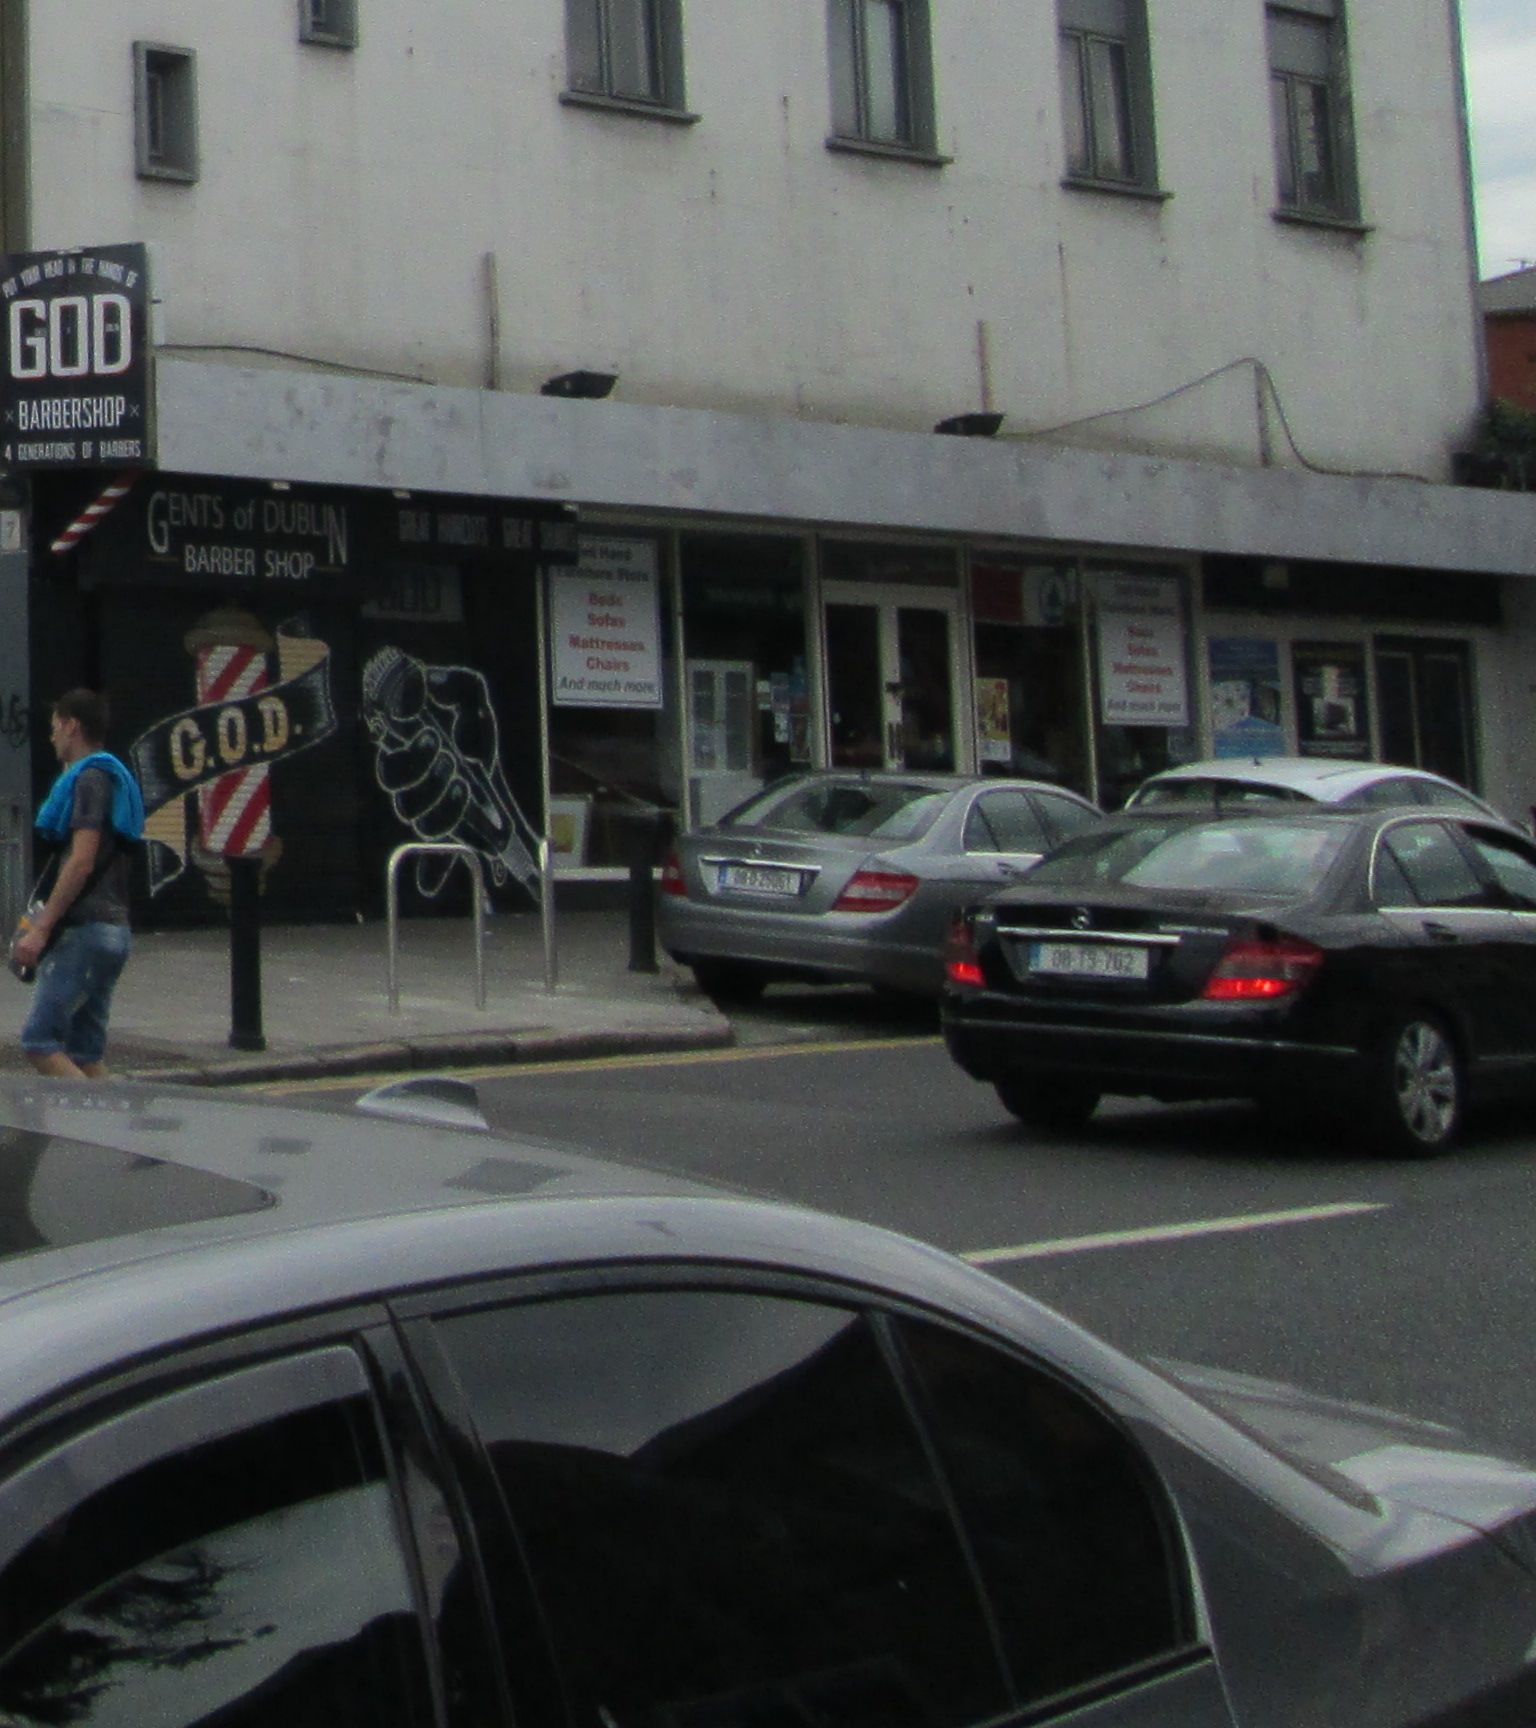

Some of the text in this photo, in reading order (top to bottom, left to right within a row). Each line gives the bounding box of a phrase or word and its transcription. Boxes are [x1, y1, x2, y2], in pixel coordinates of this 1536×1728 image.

[10, 293, 132, 379] GOD
[18, 396, 126, 430] BARBERSHOP
[4, 439, 141, 461] 4 GENERATIONS OF BARBERS
[6, 520, 16, 539] 7
[147, 490, 348, 564] GENTS of DUBLIN
[184, 543, 315, 580] BARBER SHOP
[587, 592, 623, 607] Beds
[586, 612, 627, 629] Sofas
[568, 634, 646, 652] Mattresses
[585, 656, 631, 673] Chairs
[559, 676, 656, 694] And much more
